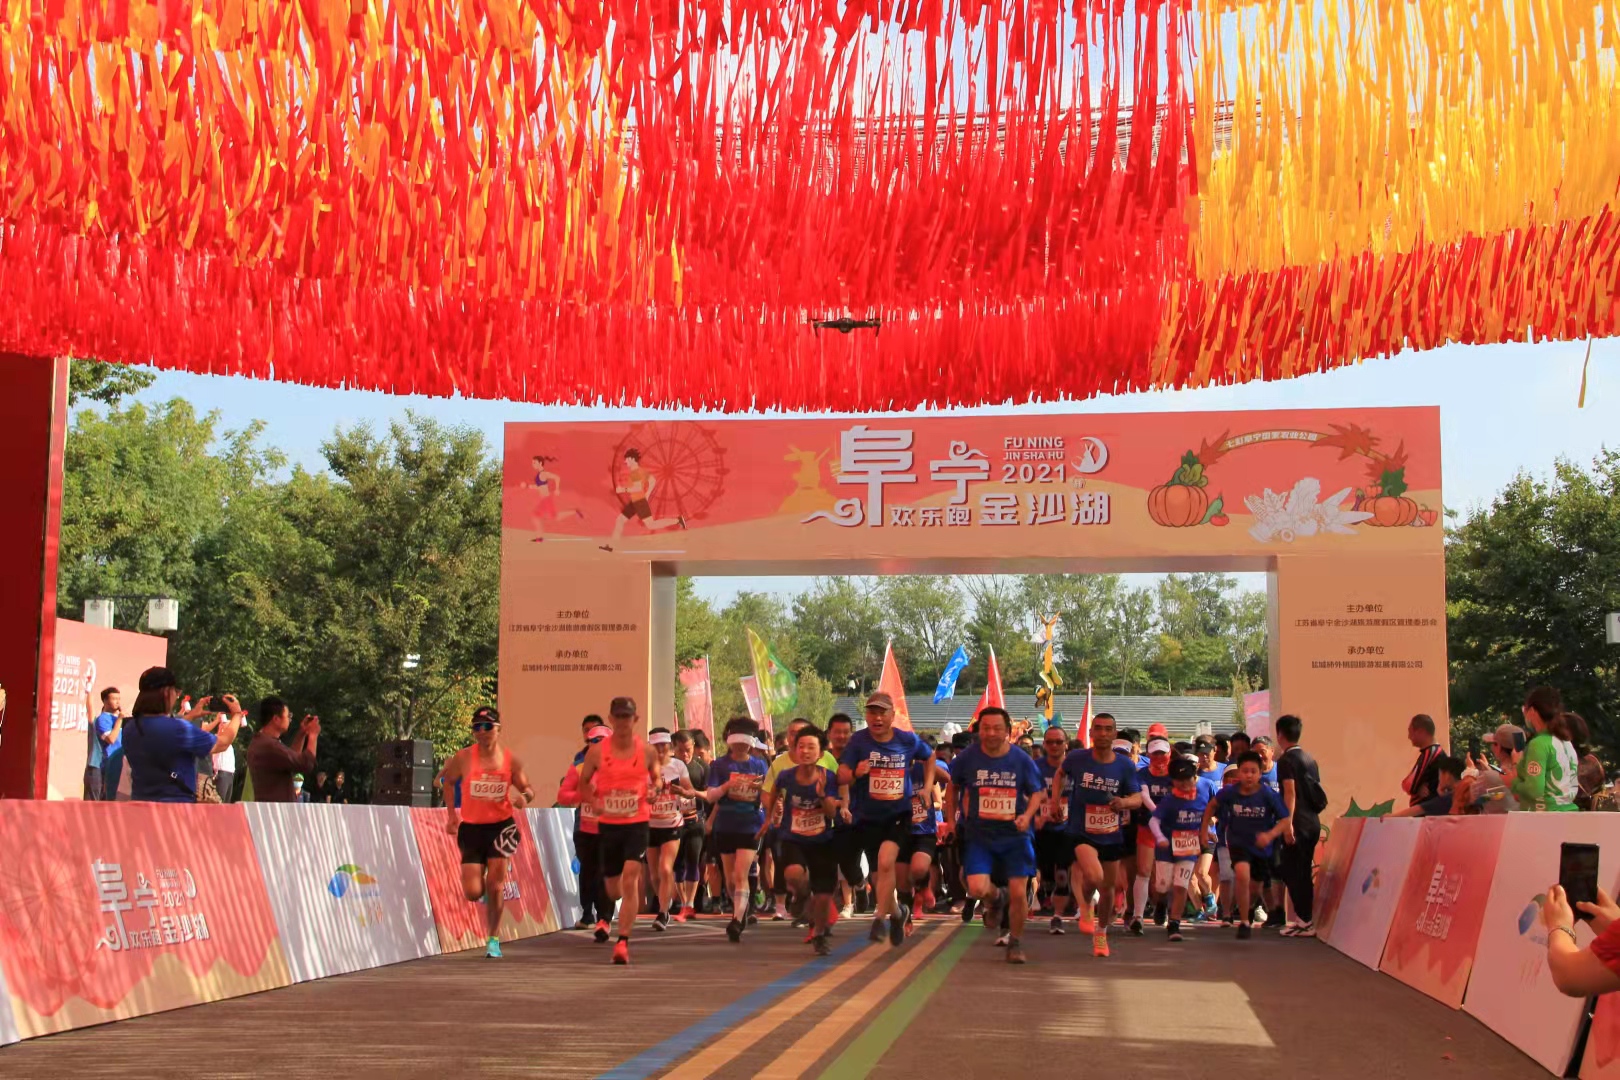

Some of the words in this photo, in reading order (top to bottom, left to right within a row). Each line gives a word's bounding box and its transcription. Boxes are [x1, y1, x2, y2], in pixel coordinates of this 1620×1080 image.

[1004, 437, 1024, 449] FU
[1028, 436, 1065, 449] NING
[1003, 451, 1021, 461] JIN
[1023, 451, 1046, 460] SHA
[1048, 451, 1065, 460] HU
[803, 425, 991, 527] 阜宁
[1002, 463, 1067, 484] 2021
[890, 496, 972, 527] 欢乐跑
[979, 492, 1112, 526] 金沙湖
[556, 610, 590, 619] 主办单位
[1346, 604, 1384, 613] 主办单位
[555, 650, 589, 659] 承办单位
[1347, 646, 1385, 655] 承办单位
[55, 676, 80, 696] 2021
[474, 783, 505, 794] 0308
[873, 779, 902, 790] 0242
[651, 802, 675, 812] 0417
[982, 798, 1012, 810] 0011
[1089, 814, 1116, 826] 0458
[1179, 867, 1191, 880] 10
[91, 858, 160, 952] 阜宁
